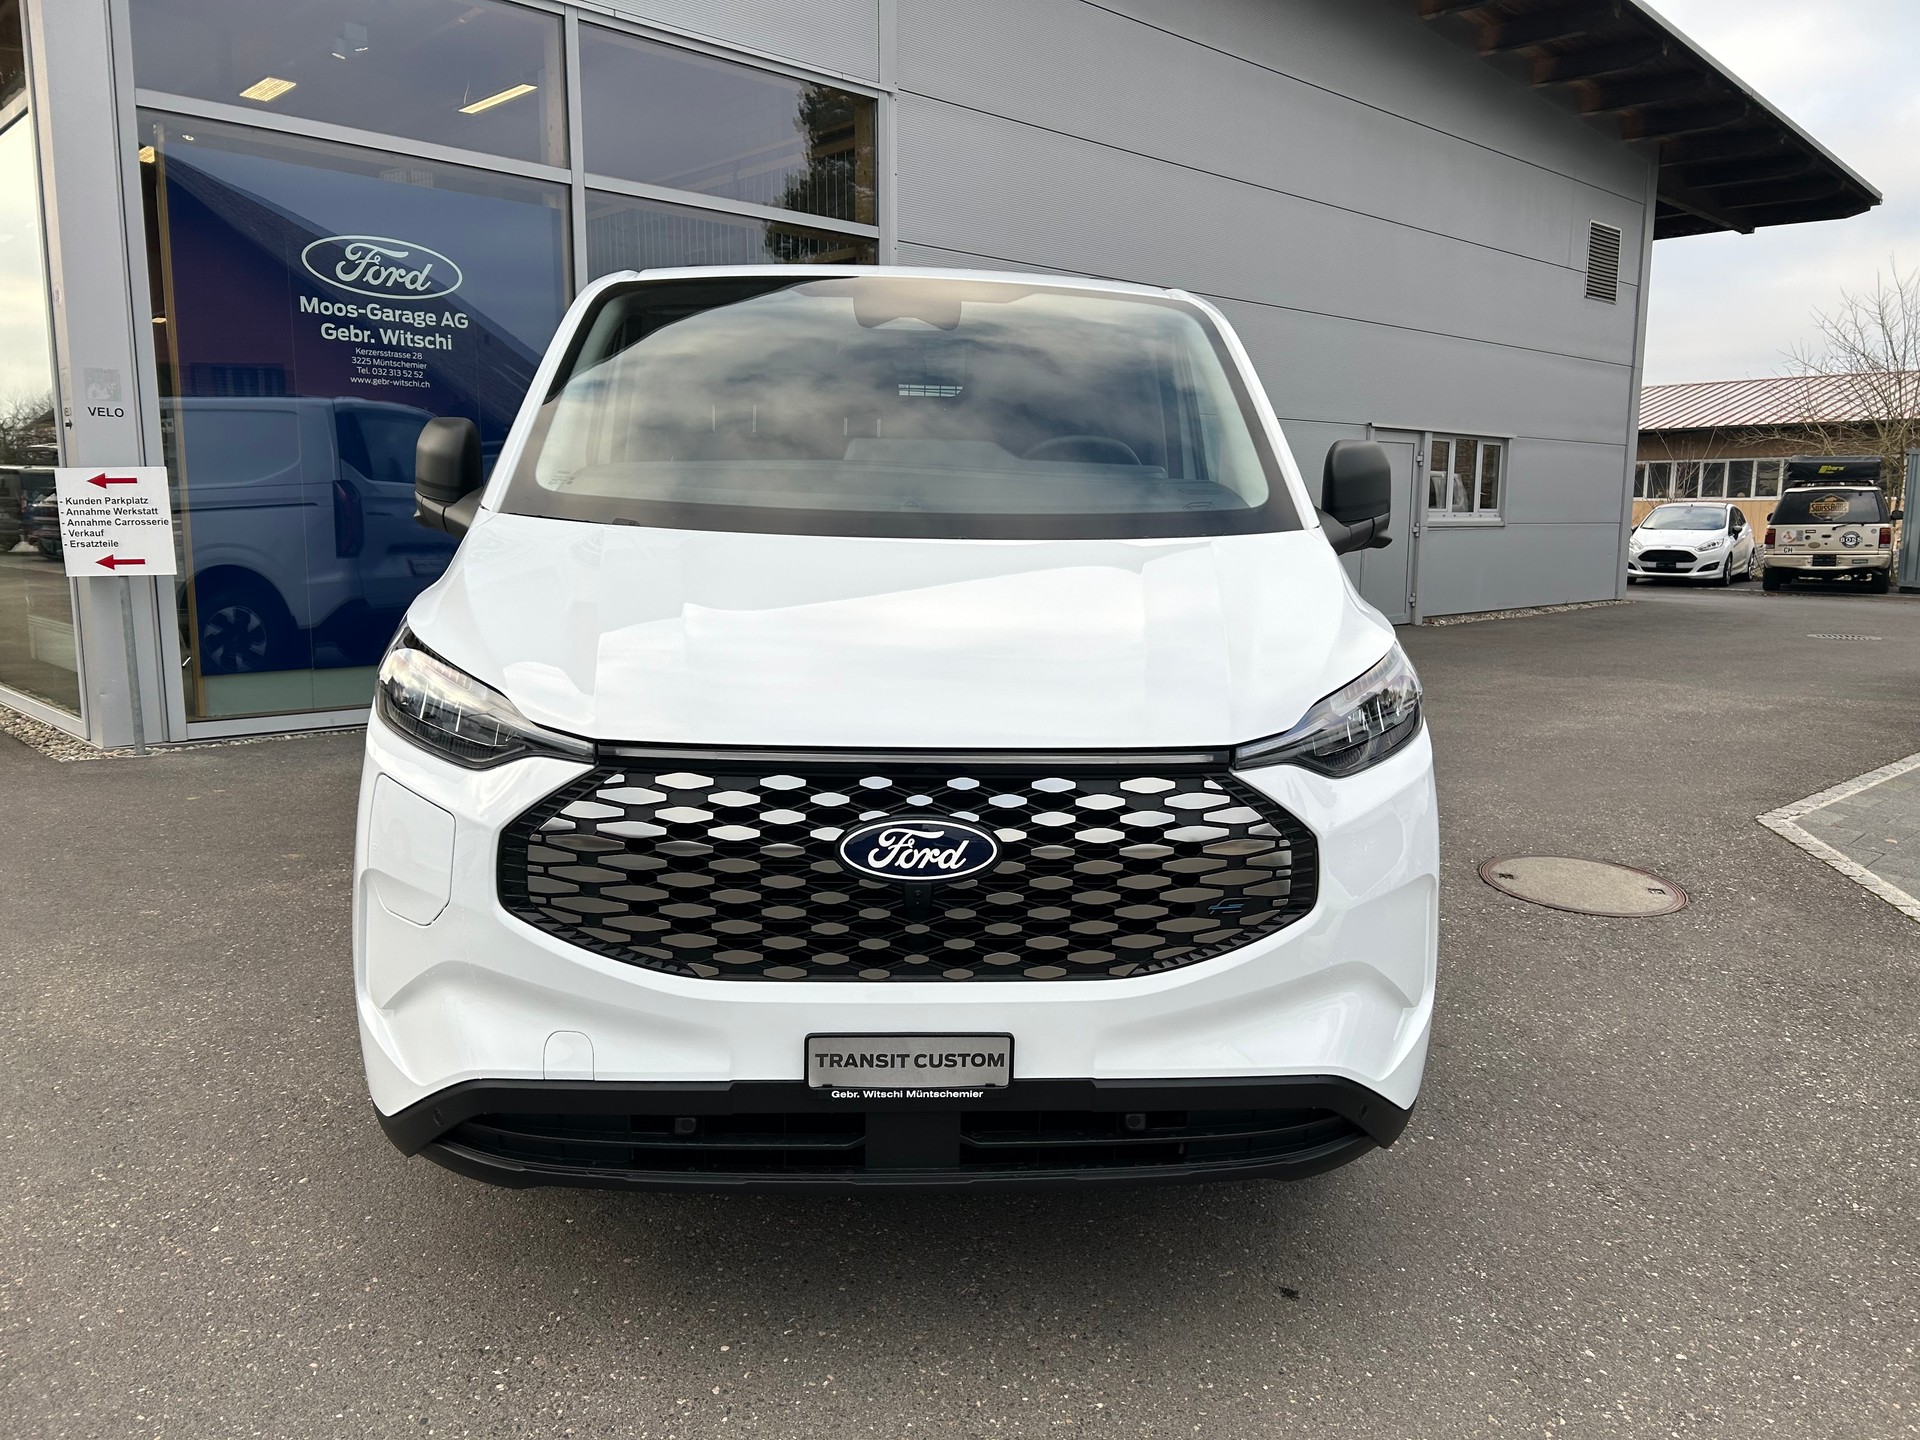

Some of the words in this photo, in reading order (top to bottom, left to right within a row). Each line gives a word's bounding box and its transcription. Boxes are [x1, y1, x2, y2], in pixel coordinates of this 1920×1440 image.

[335, 242, 433, 291] Ford
[299, 295, 437, 327] Moos-Garage
[440, 311, 469, 329] AG
[320, 322, 376, 344] Gebr.
[379, 328, 453, 350] Witschi
[355, 347, 411, 359] Kerzersstrasse
[412, 352, 423, 360] 28
[351, 356, 372, 365] 3225
[372, 358, 428, 370] Müntschemier
[356, 366, 371, 375] Tel.
[372, 367, 387, 376] 032
[388, 369, 402, 377] 313
[402, 370, 413, 378] 52
[413, 371, 424, 379] 52
[350, 376, 431, 388] www.gebr-witschi.ch
[87, 406, 125, 418] VELO
[65, 497, 102, 506] Kunden
[104, 497, 149, 507] Parkplatz
[66, 507, 111, 516] Annahme
[113, 507, 159, 516] Werkstatt
[67, 518, 112, 527] Annahme
[114, 517, 169, 527] Carrosserie
[68, 529, 105, 537] Verkauf
[69, 539, 119, 548] Ersatzteile
[867, 828, 971, 870] Ford
[814, 1052, 911, 1069] TRANSIT
[913, 1052, 1005, 1069] CUSTOM
[831, 1090, 860, 1099] Gebr.
[862, 1090, 903, 1099] Witschi
[906, 1089, 984, 1099] Müntschemier
